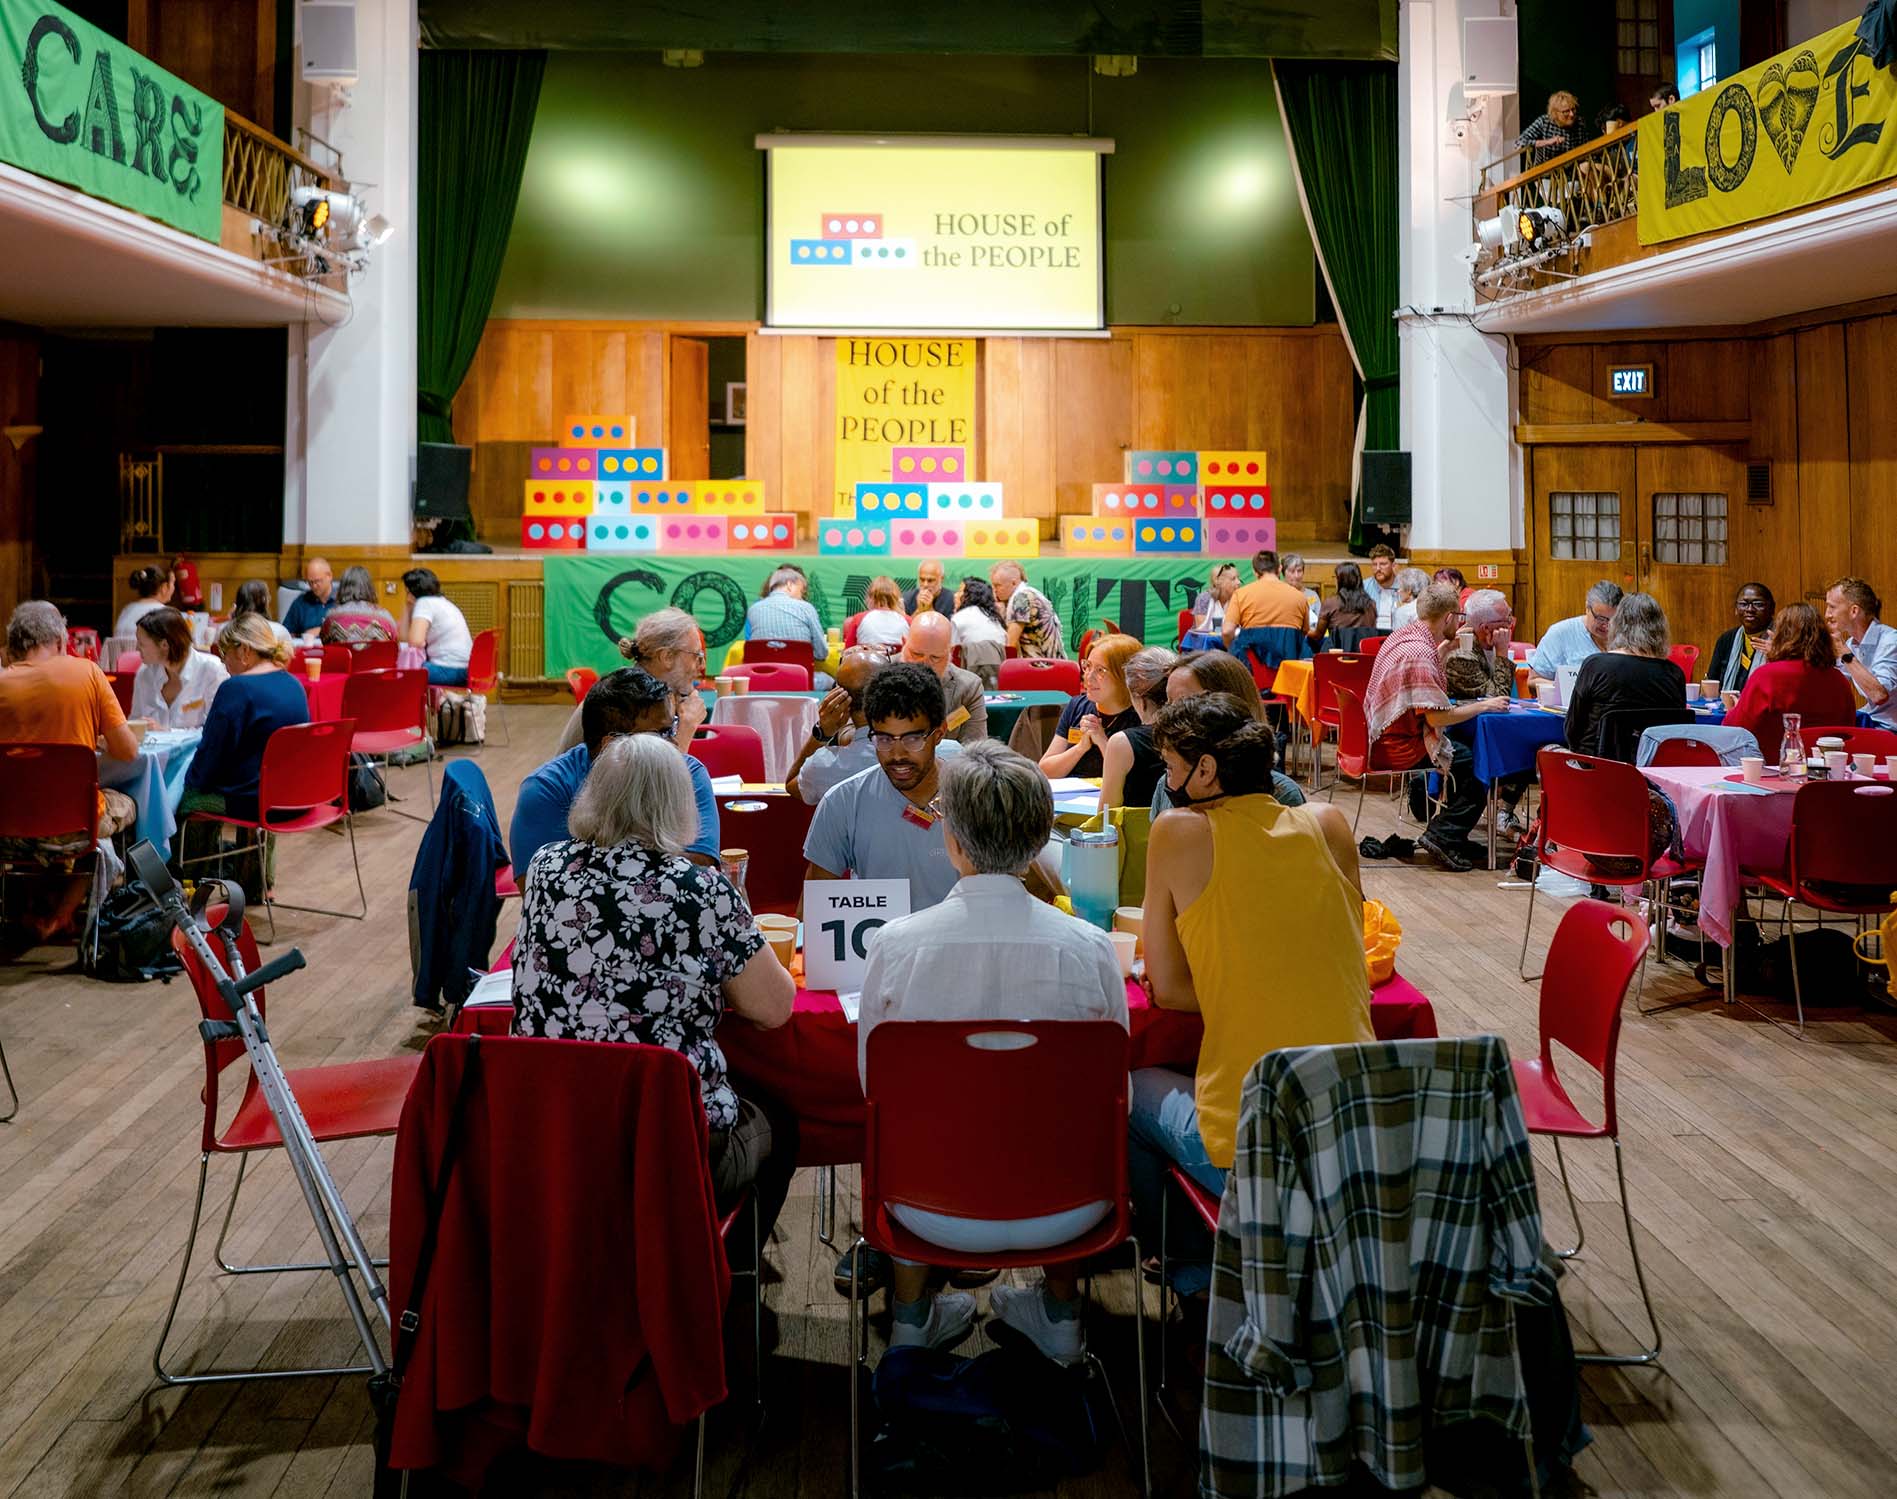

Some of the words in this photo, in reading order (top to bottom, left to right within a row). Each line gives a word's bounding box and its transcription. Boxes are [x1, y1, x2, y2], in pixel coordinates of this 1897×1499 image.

[1664, 37, 1886, 210] LOVE
[934, 214, 1036, 237] HOUSE
[1044, 213, 1073, 237] of
[923, 245, 962, 267] the
[970, 246, 1081, 268] PEOPLE
[849, 340, 964, 368] HOUSE
[863, 379, 896, 406] of
[902, 380, 945, 406] the
[1613, 371, 1645, 391] EXIT
[841, 415, 967, 444] PEOPLE
[828, 896, 887, 909] TABLE
